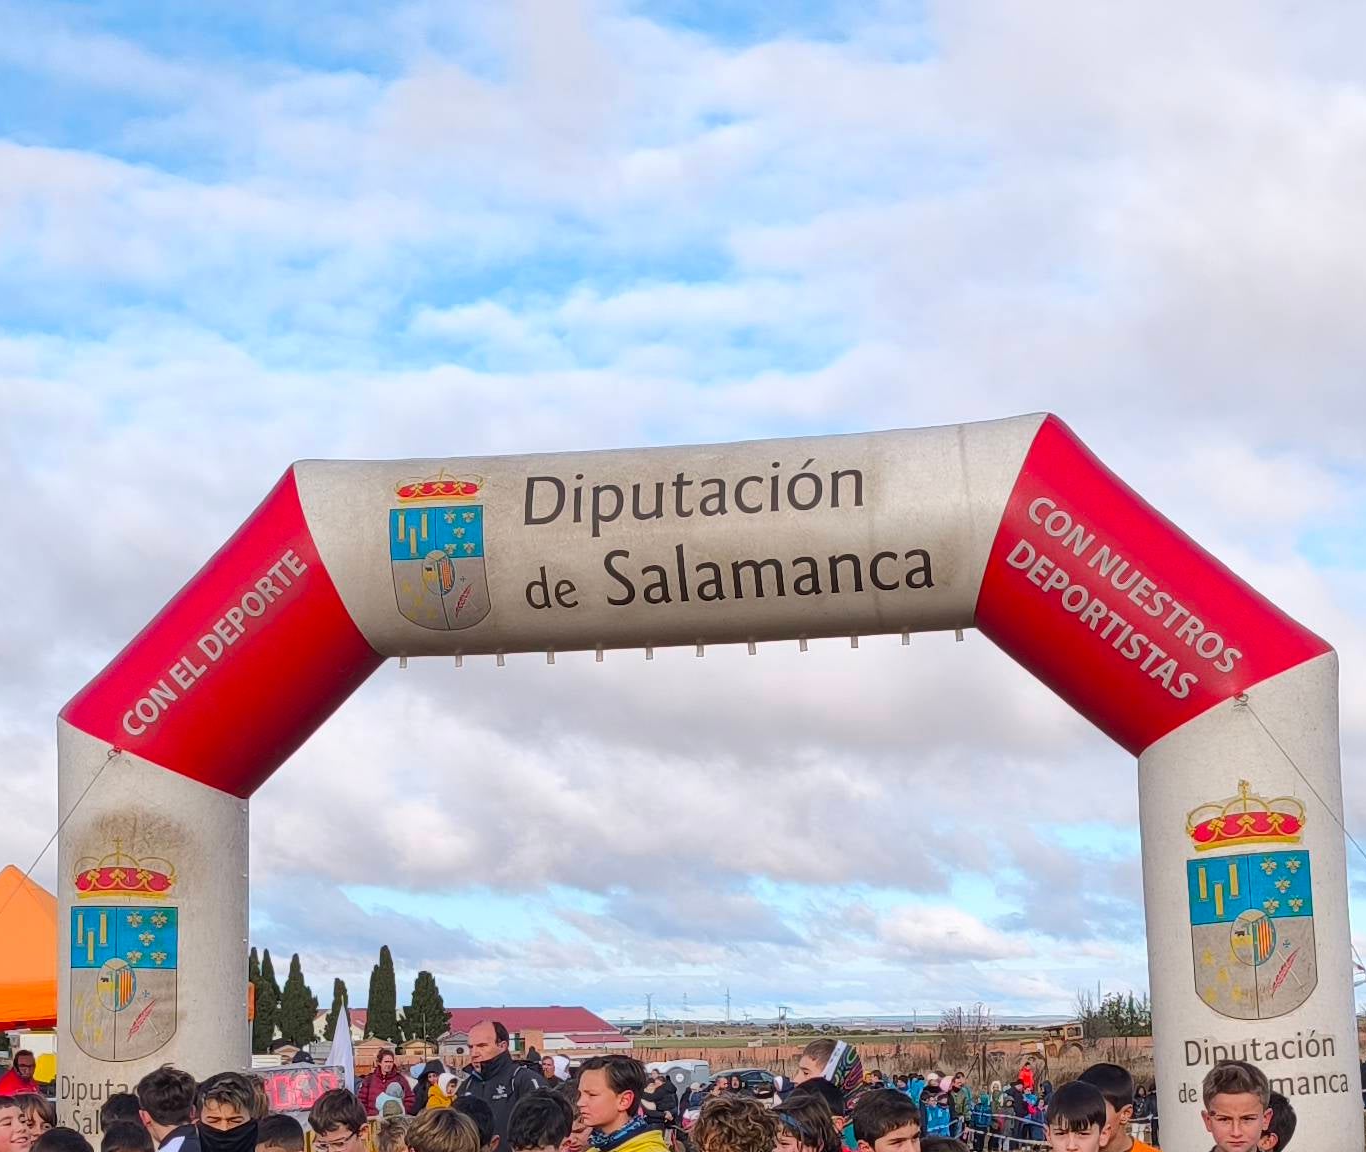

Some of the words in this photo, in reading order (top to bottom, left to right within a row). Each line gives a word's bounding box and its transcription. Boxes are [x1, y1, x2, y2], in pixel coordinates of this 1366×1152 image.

[524, 458, 864, 538] Diputación
[525, 566, 578, 610] de
[603, 544, 935, 606] Salamanca
[1028, 497, 1095, 557] CON
[1087, 545, 1242, 673] NUESTROS
[122, 679, 178, 736] CON
[169, 656, 207, 690] EL
[197, 549, 307, 661] DEPORTE
[1006, 539, 1198, 699] DEPORTISTAS
[1185, 1029, 1335, 1066] Diputación
[61, 1075, 139, 1107] Diputa
[1179, 1082, 1198, 1104] de
[1269, 1073, 1348, 1097] manca
